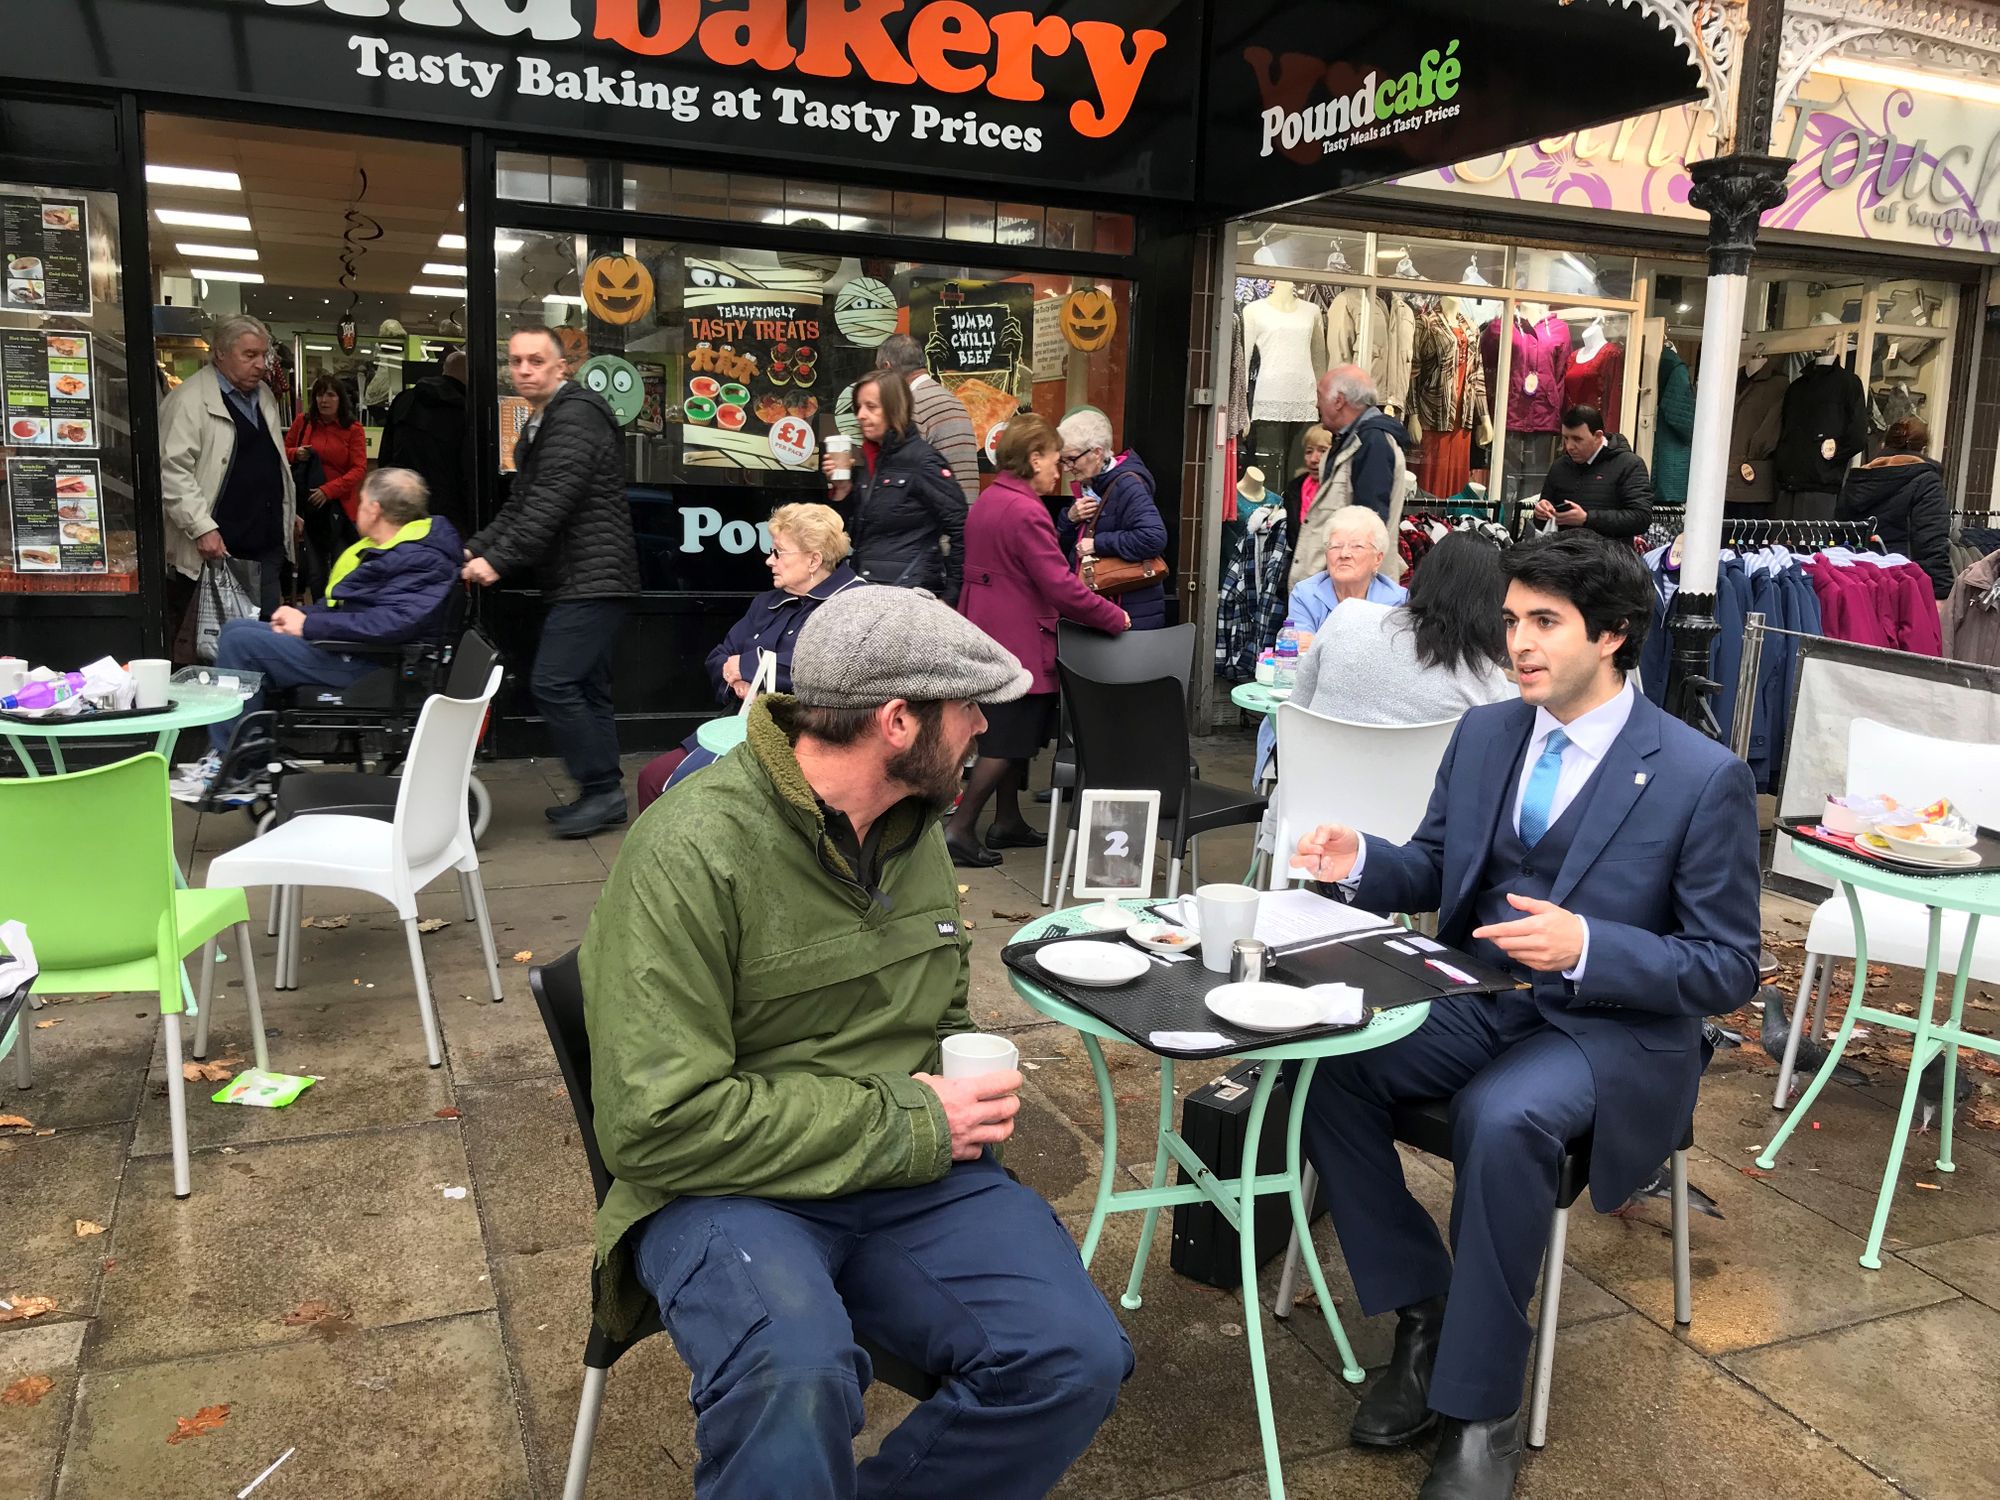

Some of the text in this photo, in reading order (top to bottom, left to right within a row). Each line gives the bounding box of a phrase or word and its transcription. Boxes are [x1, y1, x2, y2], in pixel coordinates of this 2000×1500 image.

[347, 34, 1042, 153] Tasty Baking at Tasty Prices
[1260, 39, 1462, 157] Poundcafé
[1323, 104, 1460, 154] Tasty Meals at Tasty Prices
[1874, 202, 1901, 224] of
[717, 305, 797, 320] TERRIFYINGLY
[951, 312, 994, 330] JUMBO
[689, 319, 820, 342] TASTY TREATS
[951, 330, 996, 349] CHILLI
[957, 348, 993, 366] BEEF
[777, 422, 807, 450] £1
[774, 443, 805, 458] PER PACK
[1103, 830, 1129, 858] 2
